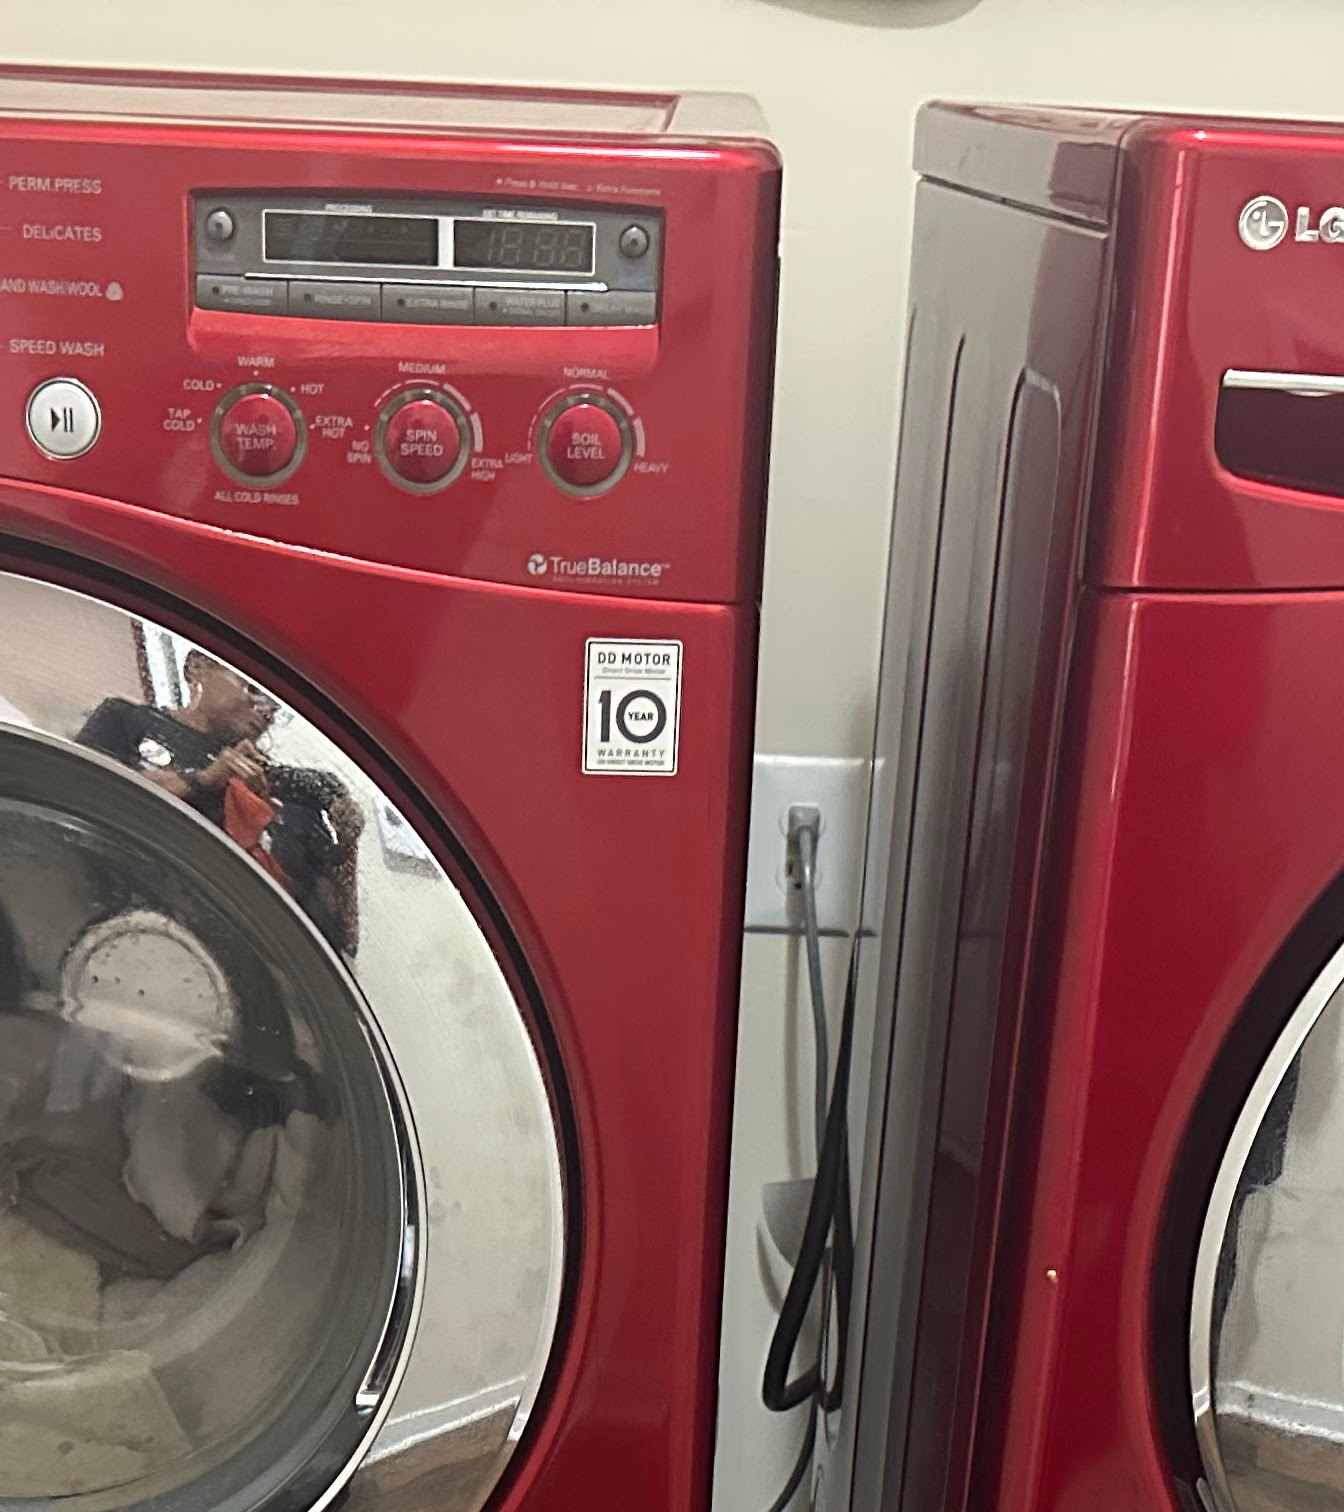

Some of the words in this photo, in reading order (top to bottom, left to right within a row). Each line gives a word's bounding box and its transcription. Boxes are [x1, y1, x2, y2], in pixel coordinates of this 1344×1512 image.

[22, 224, 103, 241] DELICATES
[9, 338, 56, 354] SPEED
[60, 341, 104, 356] WASH
[237, 356, 274, 368] WARM
[397, 361, 446, 375] MEDIUM
[563, 366, 610, 380] NORMAL
[183, 379, 215, 391] COLD
[300, 383, 324, 395] HOT
[167, 408, 191, 420] TAP
[163, 420, 195, 431] COLD
[315, 415, 353, 428] EXTRA
[235, 423, 277, 436] WASH
[322, 426, 346, 438] HOT
[405, 429, 437, 443] SPIN
[571, 432, 601, 447] SOIL
[400, 443, 444, 458] SPEED
[567, 446, 606, 460] LEVEL
[634, 461, 669, 474] HEAVY
[597, 651, 617, 665] DD
[621, 651, 672, 666] MOTOR
[598, 689, 667, 744] 10
[628, 711, 654, 721] YEAR
[598, 748, 666, 759] WARRANTY
